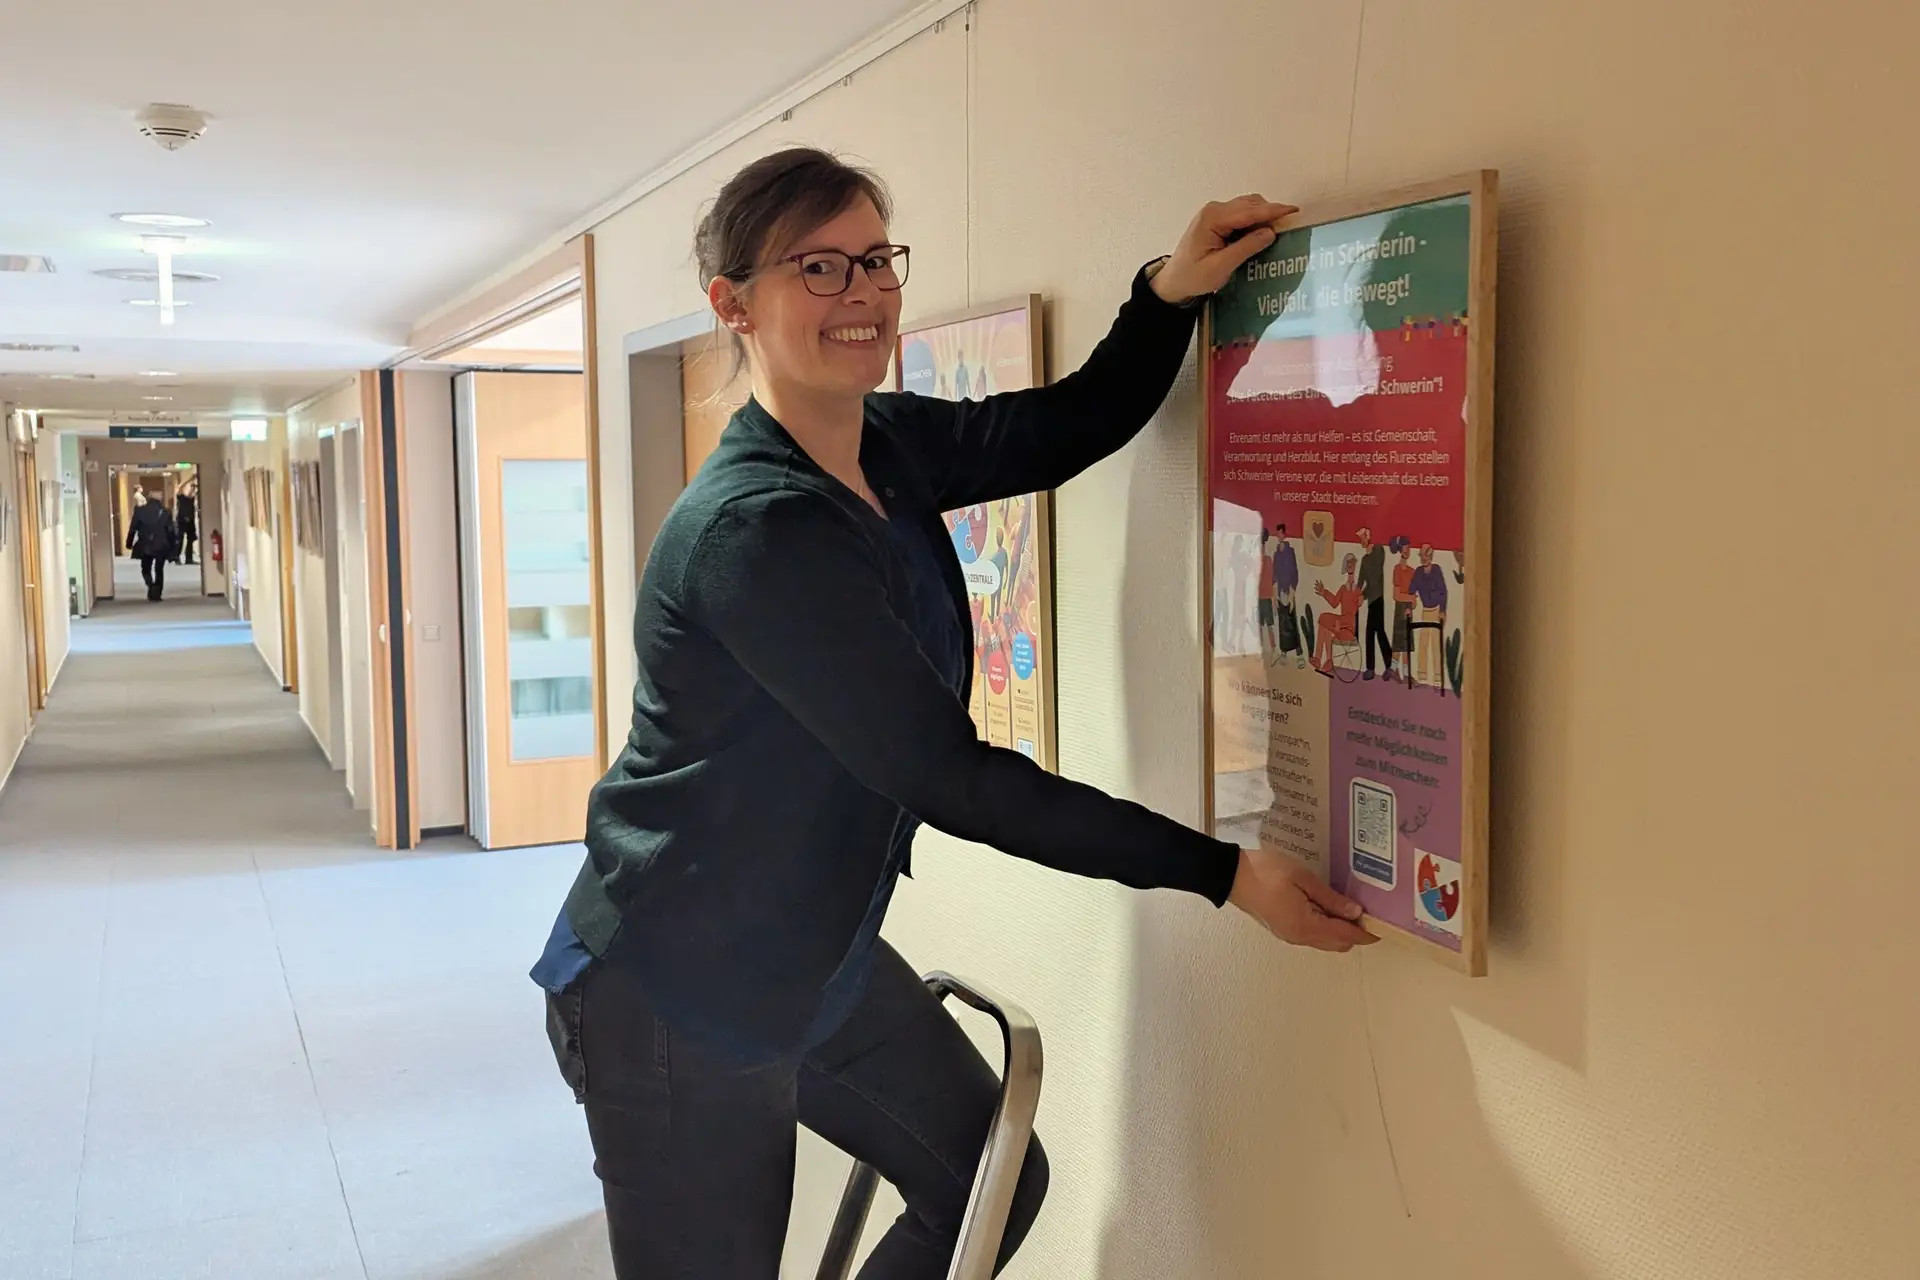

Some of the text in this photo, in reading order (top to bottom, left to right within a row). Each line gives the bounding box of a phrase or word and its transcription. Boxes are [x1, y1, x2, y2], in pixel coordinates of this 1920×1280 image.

[1247, 253, 1316, 282] Ehrenamt
[1320, 247, 1335, 270] in
[1338, 231, 1416, 266] Schwerin
[1257, 273, 1411, 317] Vielfalt, die bewegt!
[1229, 431, 1261, 444] Ehrenamt
[1262, 431, 1271, 443] ist
[1272, 431, 1291, 443] mehr
[1291, 430, 1302, 443] als
[1303, 432, 1317, 443] nur
[1318, 429, 1344, 443] Helfen
[1351, 431, 1361, 442] es
[1362, 429, 1373, 442] ist
[1374, 427, 1438, 444] Gemeinschaft,
[1223, 449, 1450, 467] Verantwortung und Herzblut. Hier entlang des Flures stellen
[1223, 468, 1449, 486] sich Schweriner Vereine vor, die mit Leidenschaft das Leben
[1273, 489, 1379, 505] in unserer Stadt bereichern.
[1241, 680, 1271, 699] können
[1272, 688, 1284, 702] Sie
[1285, 692, 1303, 707] sich
[1241, 703, 1290, 725] engagieren?
[1348, 706, 1447, 741] Entdecken Sie noch
[1346, 731, 1448, 766] mehr Möglichkeiten
[1355, 755, 1377, 770] zum
